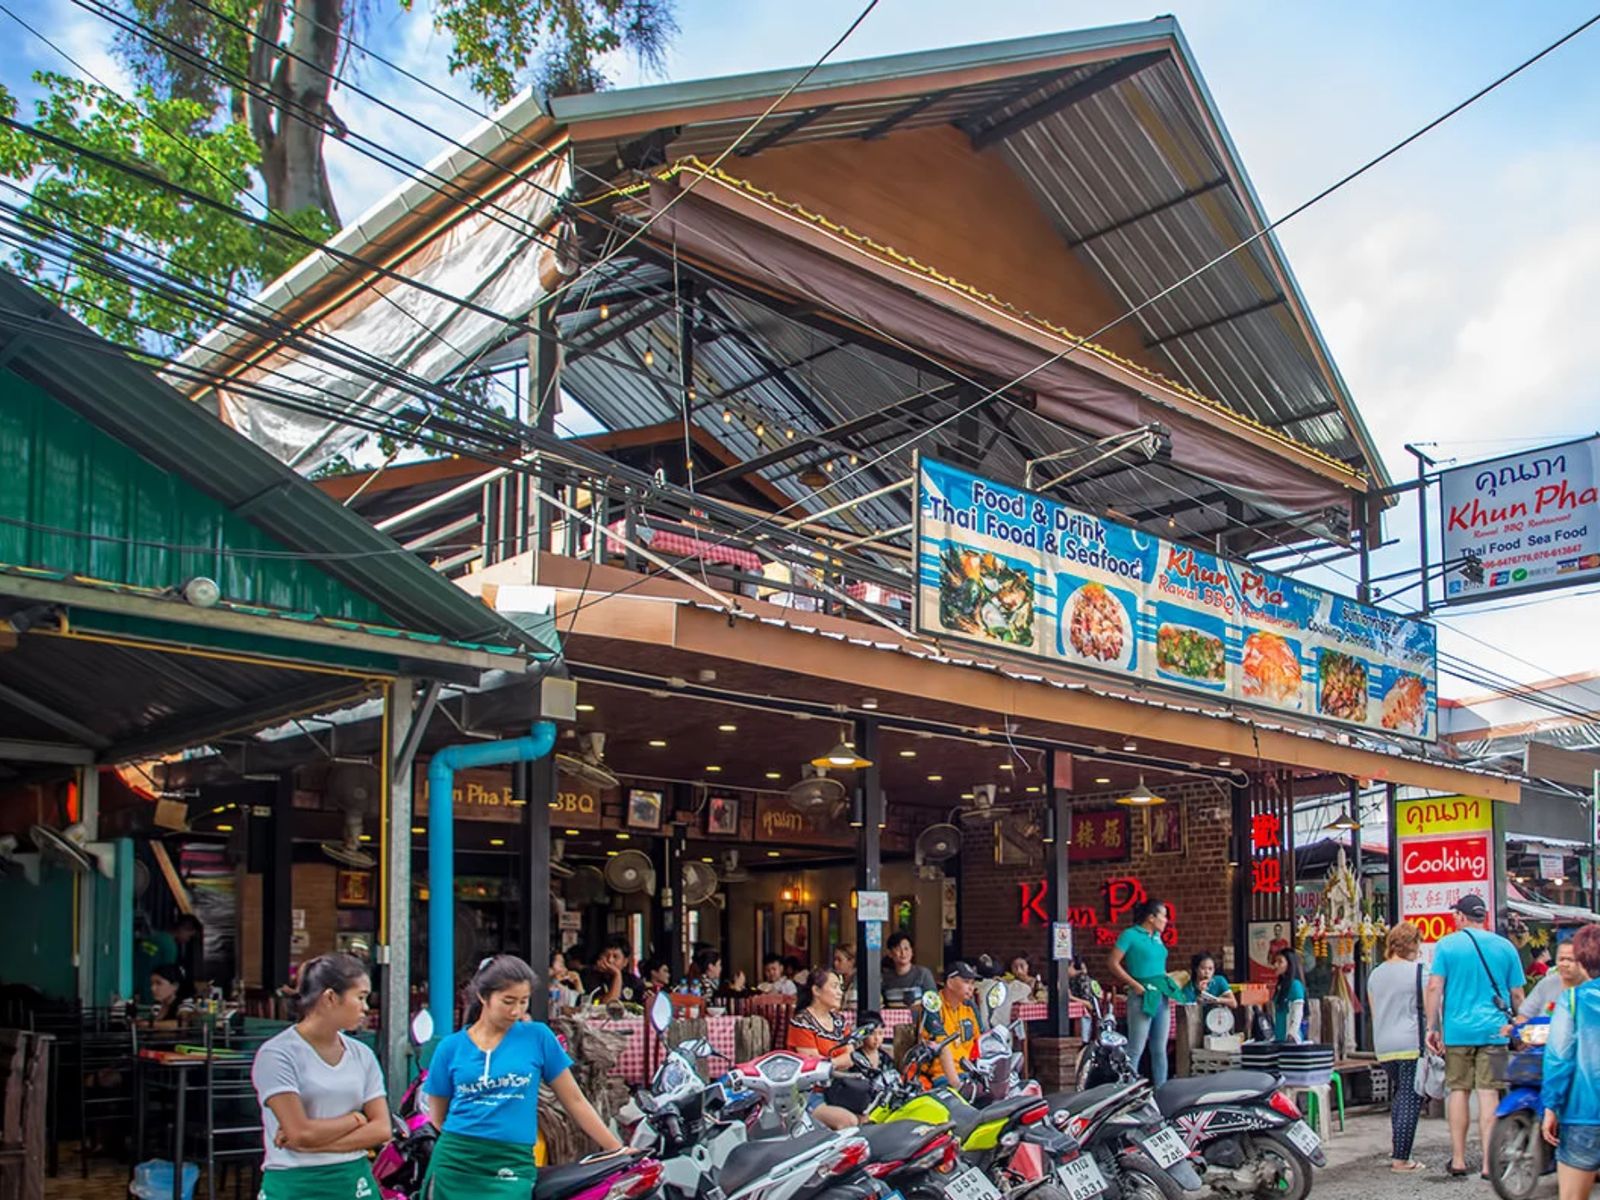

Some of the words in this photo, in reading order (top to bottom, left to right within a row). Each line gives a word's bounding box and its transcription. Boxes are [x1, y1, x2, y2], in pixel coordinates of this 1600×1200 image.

[1475, 455, 1566, 497] คุณภา
[973, 481, 1023, 518] Food
[1032, 502, 1048, 525] &
[1055, 508, 1105, 545] Drink
[1447, 498, 1527, 531] Khun
[1535, 480, 1598, 514] Pha
[1503, 521, 1524, 533] BBQ
[1528, 513, 1571, 529] Restaurant
[930, 496, 976, 531] Thai
[986, 514, 1035, 549] Food
[1044, 534, 1058, 556] &
[1066, 538, 1143, 580] Seafood
[1460, 545, 1486, 558] Thai
[1489, 538, 1520, 554] Food
[1527, 534, 1551, 546] Sea
[1555, 525, 1587, 541] Food
[1167, 547, 1230, 589] Khun
[1241, 570, 1284, 607] Pha
[1158, 573, 1199, 600] Rawai
[1203, 588, 1236, 616] BBQ
[1241, 601, 1300, 631] Restaurant
[466, 783, 499, 807] Pha
[1406, 800, 1480, 833] คุณภา
[1403, 846, 1486, 879] Cooking
[1017, 879, 1097, 928] Kun
